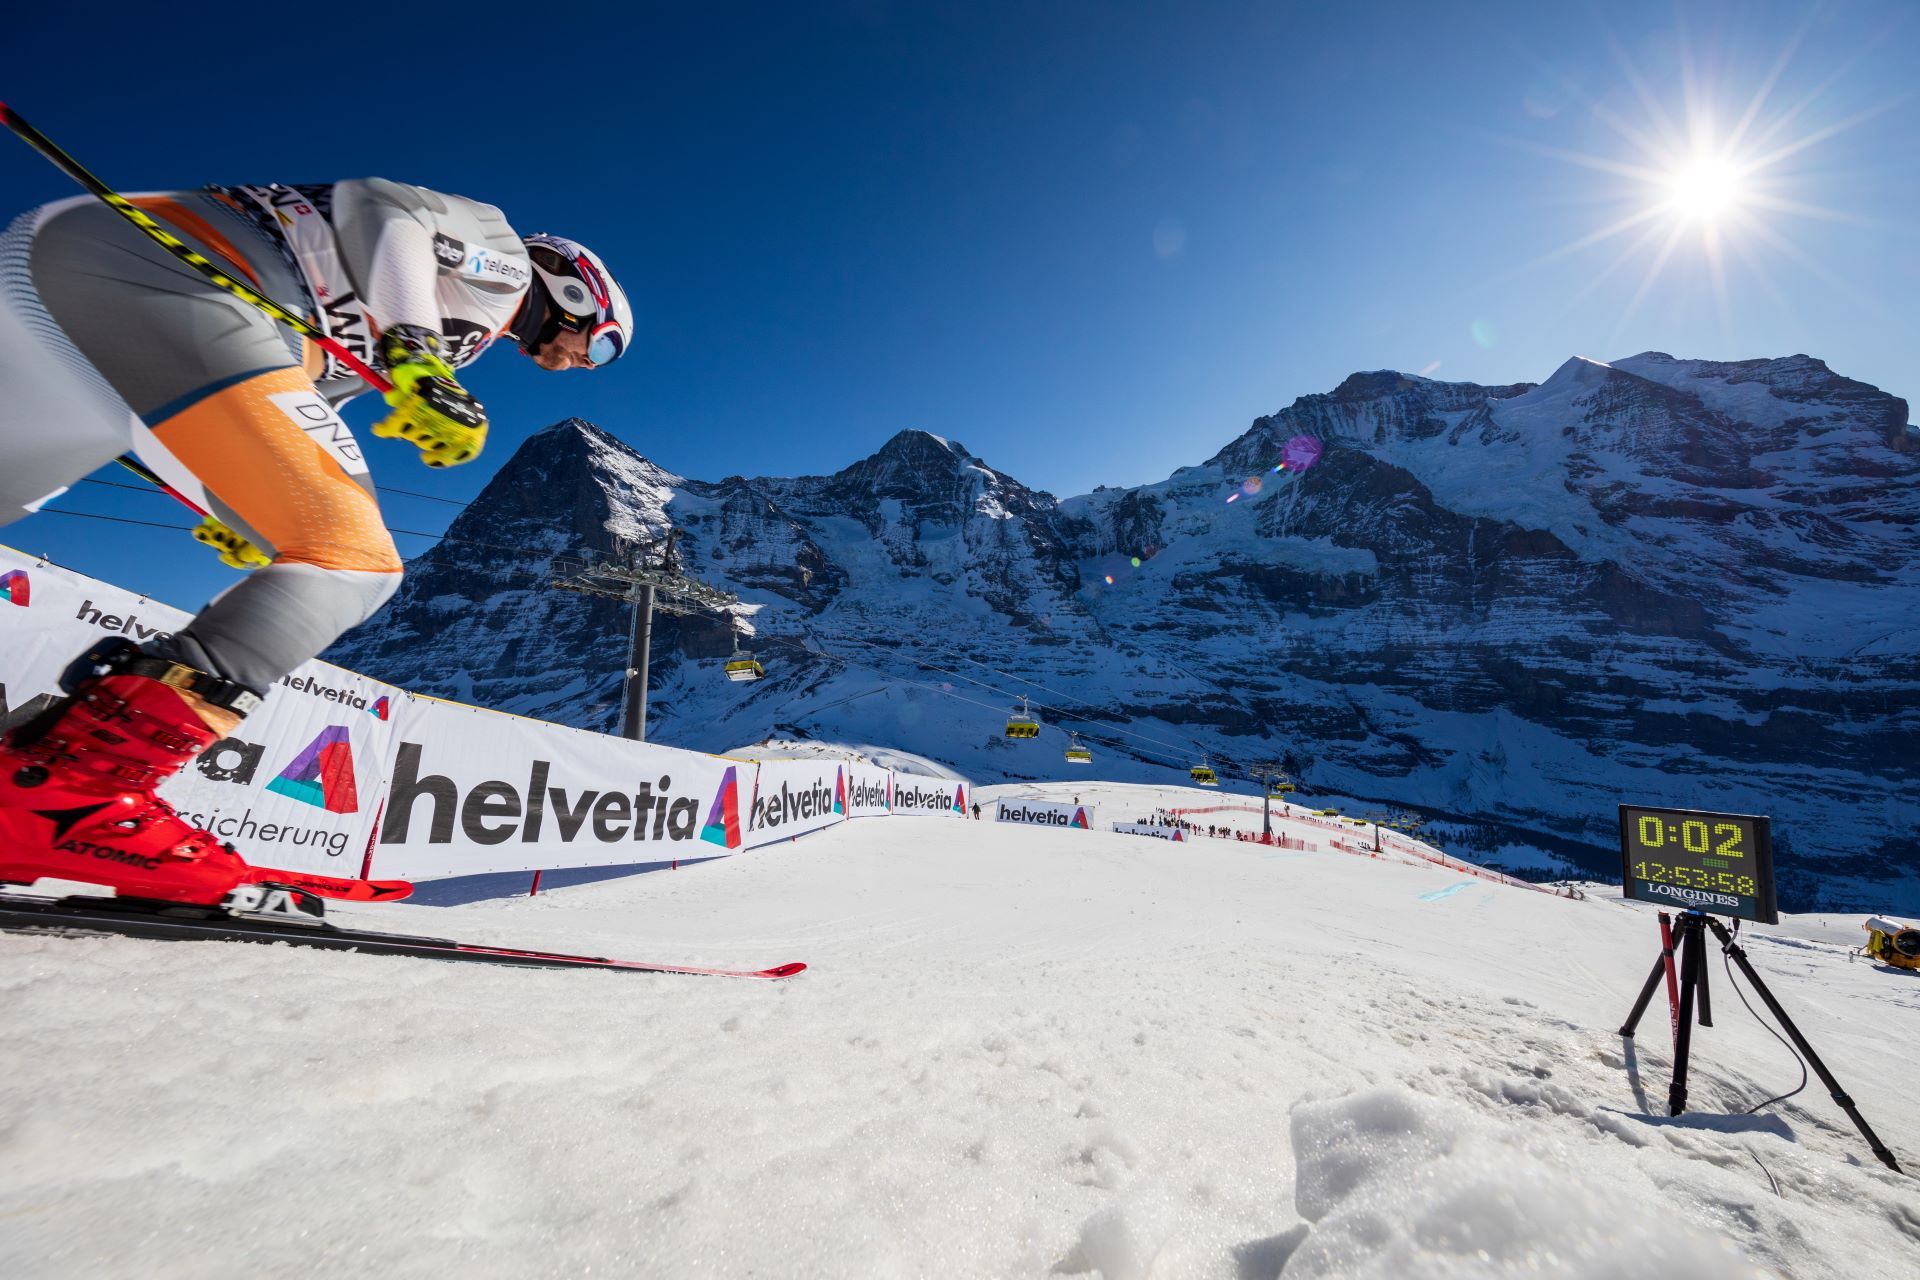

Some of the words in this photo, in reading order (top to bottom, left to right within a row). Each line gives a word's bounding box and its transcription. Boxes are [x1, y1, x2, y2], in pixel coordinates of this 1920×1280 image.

[75, 600, 174, 642] helve
[381, 742, 699, 844] helvetia
[749, 776, 832, 832] helvetia
[850, 775, 885, 808] helvetia
[894, 783, 952, 810] helvetia
[176, 808, 350, 857] rsicherung
[1000, 803, 1069, 826] helvetia
[53, 839, 164, 871] ATOMIC
[1638, 815, 1744, 858] 0:02
[1635, 860, 1755, 897] 12:53:58
[1647, 882, 1740, 908] LONGINES
